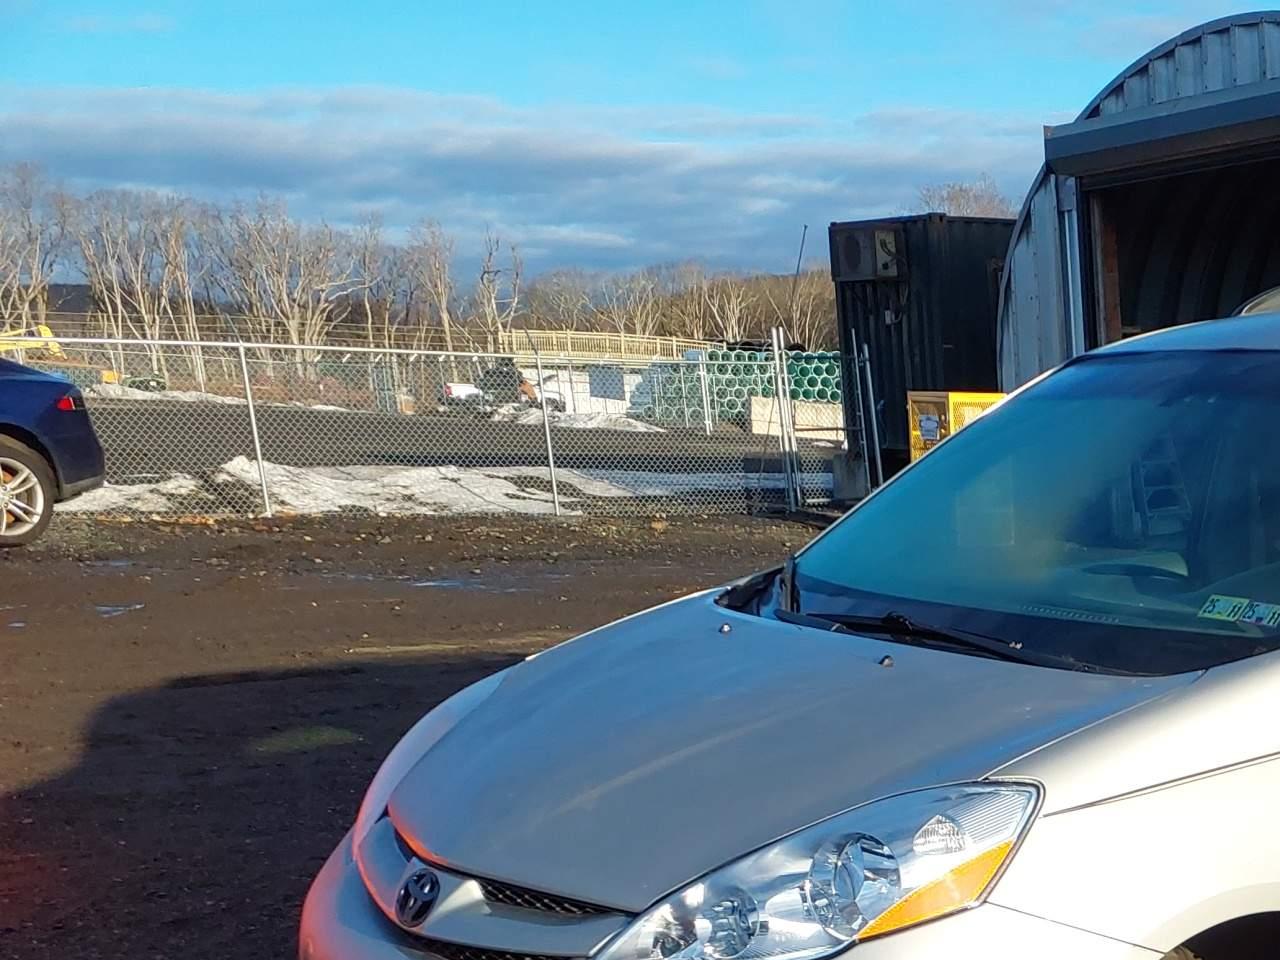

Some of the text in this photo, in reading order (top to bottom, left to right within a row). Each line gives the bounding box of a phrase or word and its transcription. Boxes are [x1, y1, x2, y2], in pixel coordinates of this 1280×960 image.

[1203, 598, 1242, 619] 25 11
[1243, 604, 1259, 619] 25
